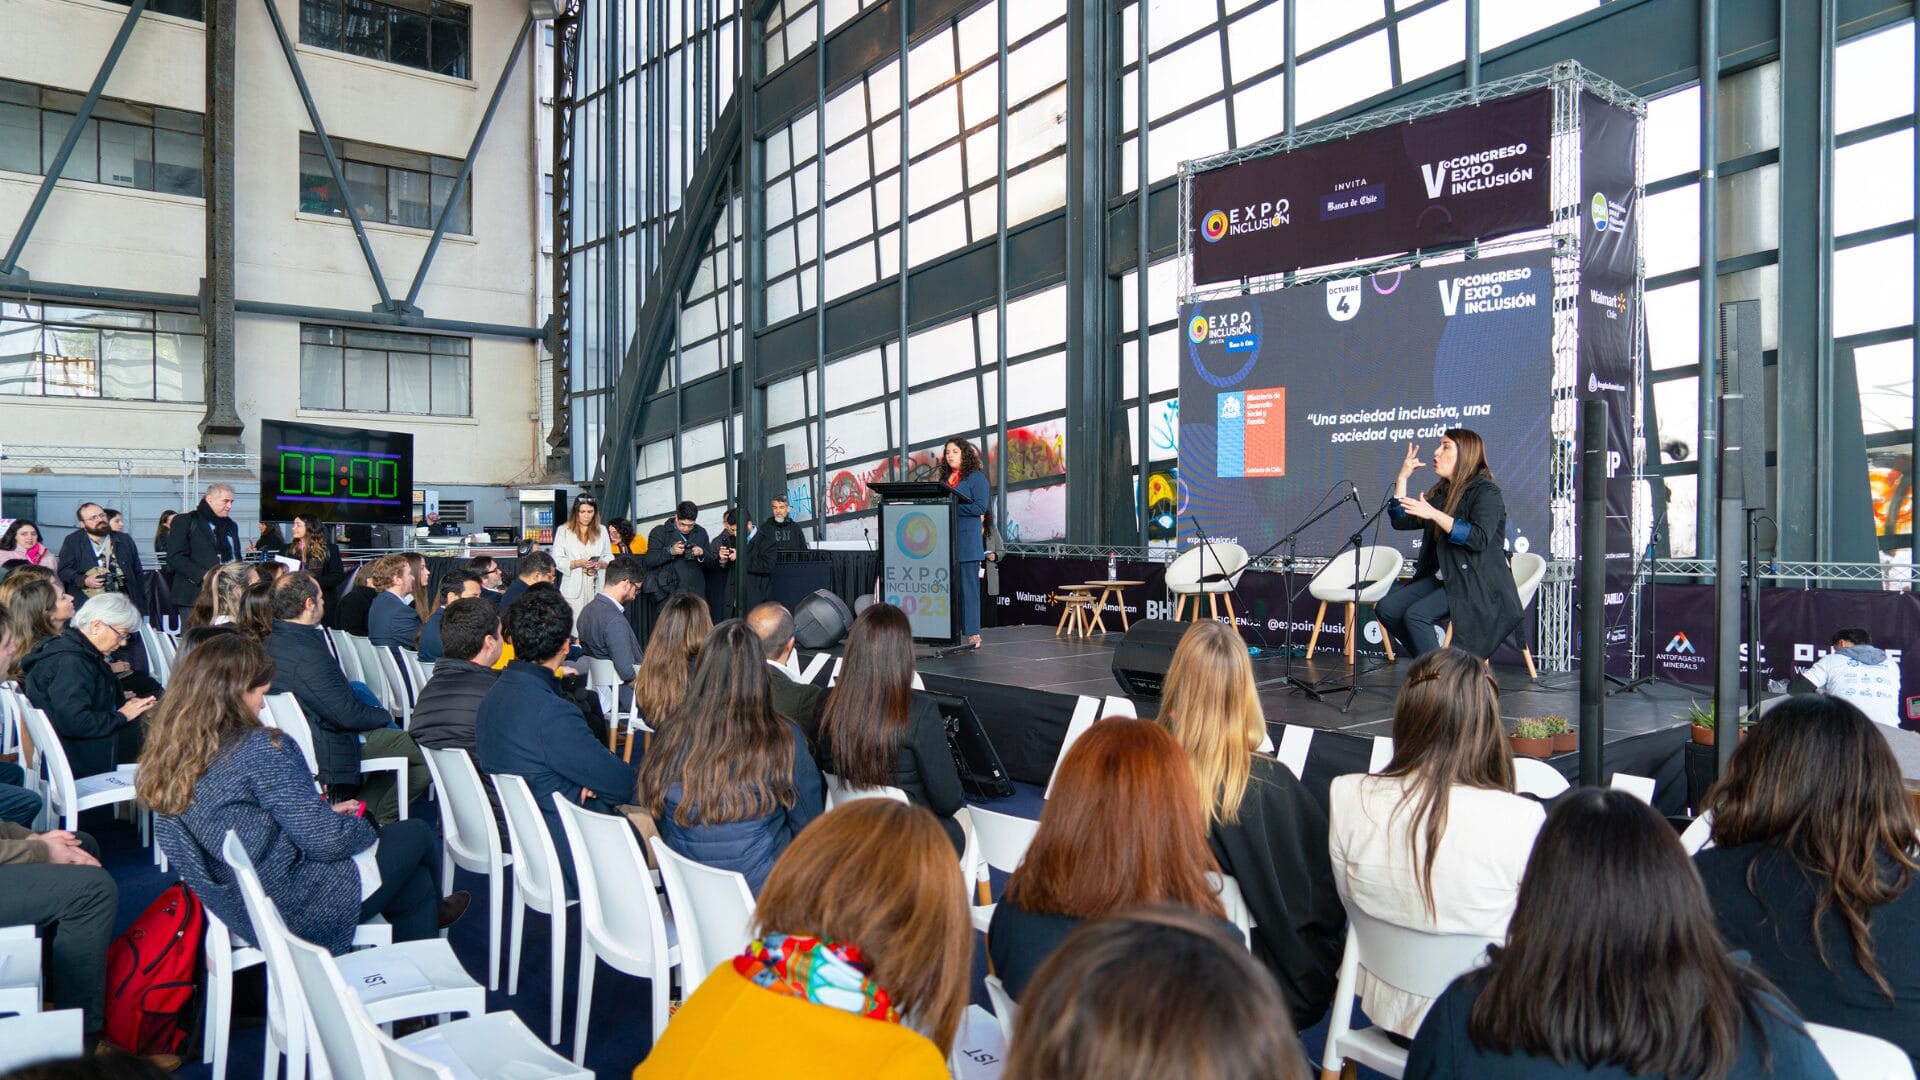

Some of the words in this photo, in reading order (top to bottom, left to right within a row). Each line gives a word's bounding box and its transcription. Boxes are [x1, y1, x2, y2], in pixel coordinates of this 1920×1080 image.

[1450, 143, 1528, 169] CONGRESO
[1451, 163, 1494, 182] EXPO
[1451, 168, 1533, 195] INCLUSIÓN
[1334, 178, 1367, 192] INVITA
[1229, 199, 1290, 224] EXPO
[1327, 201, 1349, 211] Banco
[1350, 199, 1358, 207] de
[1359, 195, 1378, 205] Chile
[1463, 267, 1532, 288] CONGRESO
[1464, 284, 1503, 301] EXPO
[1590, 289, 1618, 308] Walmart
[1336, 295, 1350, 314] 4
[1464, 292, 1537, 315] INCLUSIÓN
[1208, 311, 1252, 329] EXPO
[1339, 407, 1396, 425] sociedad
[1398, 403, 1460, 421] inclusiva,
[1462, 403, 1491, 417] una
[1330, 426, 1388, 444] sociedad
[1389, 428, 1414, 443] que
[280, 452, 398, 498] 00:00
[886, 566, 949, 582] EXPO
[887, 595, 948, 617] 2023
[1016, 591, 1047, 604] Walmart
[1034, 603, 1047, 612] Chile
[1656, 654, 1705, 663] ANTOFAGASTA
[1663, 661, 1698, 670] MINERALS
[363, 973, 387, 987] IST
[962, 1049, 999, 1066] IST
